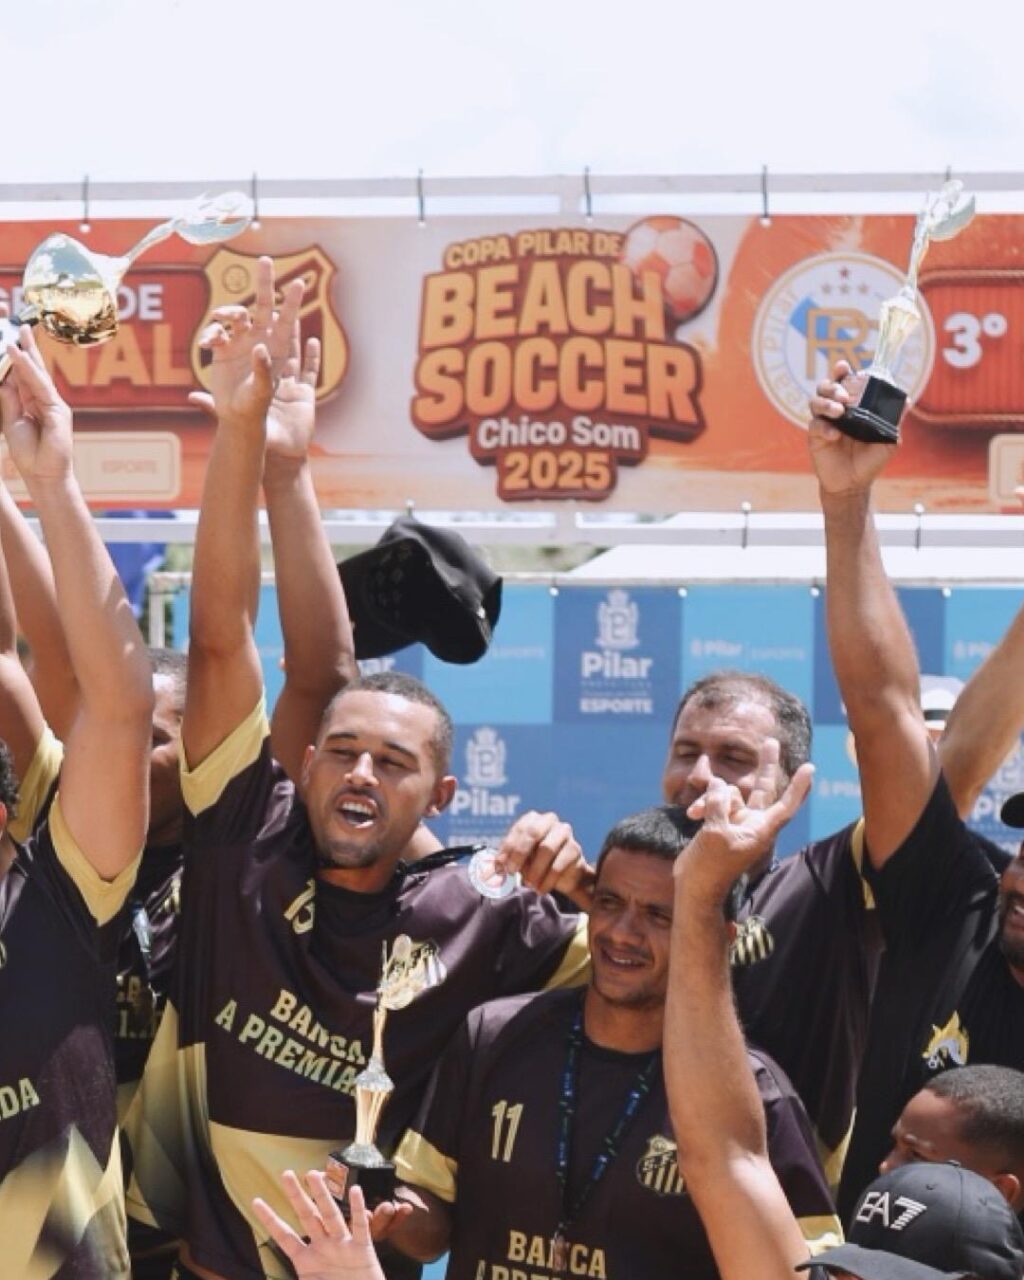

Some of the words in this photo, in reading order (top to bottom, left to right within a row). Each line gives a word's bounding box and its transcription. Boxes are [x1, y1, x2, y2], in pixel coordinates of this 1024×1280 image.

[446, 238, 510, 267] COPA
[518, 232, 589, 256] PILAR
[593, 233, 624, 258] DE
[423, 258, 667, 345] BEACH
[414, 336, 697, 424] SOCCER
[478, 417, 566, 449] Chico
[572, 416, 640, 449] Som
[503, 451, 611, 490] 2025
[581, 650, 653, 678] Pilar
[450, 785, 520, 814] Pilar
[214, 999, 237, 1032] A
[239, 1014, 357, 1096] PREMIA
[270, 989, 365, 1064] BANCA
[491, 1100, 524, 1163] 11
[856, 1191, 927, 1231] EA7
[507, 1229, 607, 1280] BACA
